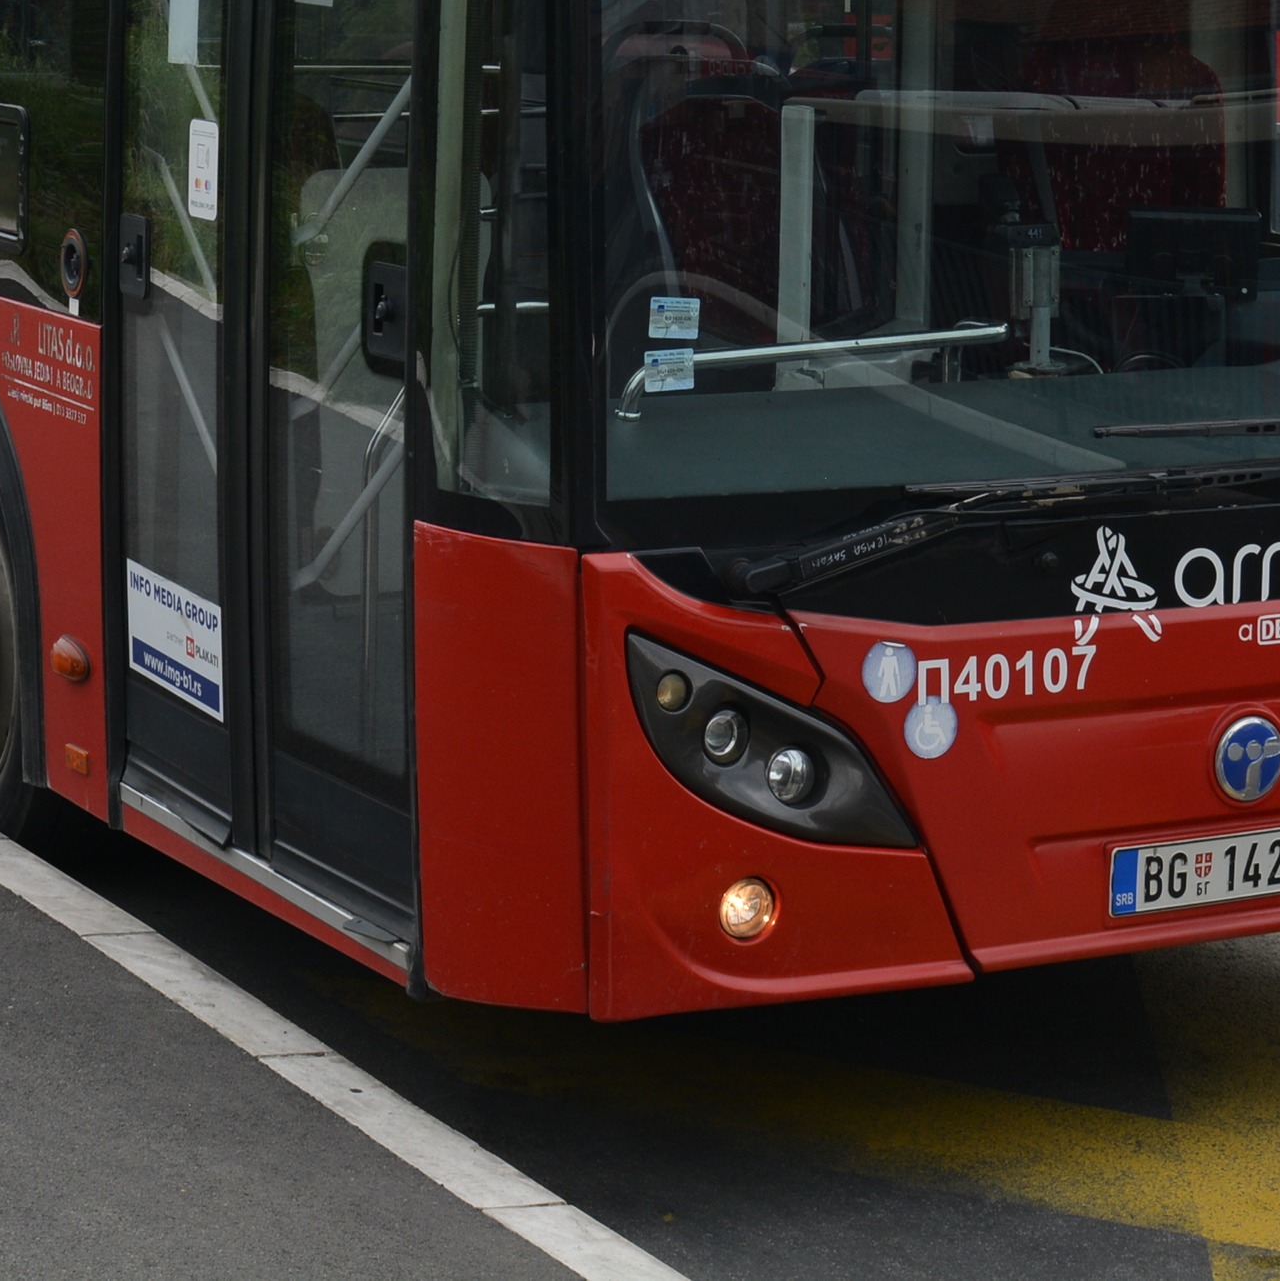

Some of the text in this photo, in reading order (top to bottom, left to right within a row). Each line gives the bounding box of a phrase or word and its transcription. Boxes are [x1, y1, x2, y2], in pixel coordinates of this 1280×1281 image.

[38, 321, 64, 362] LITAS
[129, 570, 219, 633] INFO MEDIA GROUP
[1238, 623, 1253, 642] a
[143, 651, 203, 697] www.img-b1.rs
[195, 646, 219, 668] PLAKATI
[917, 644, 1097, 707] П40107
[1115, 891, 1134, 907] SRB
[1143, 851, 1188, 903] BG
[1195, 881, 1211, 897] БГ
